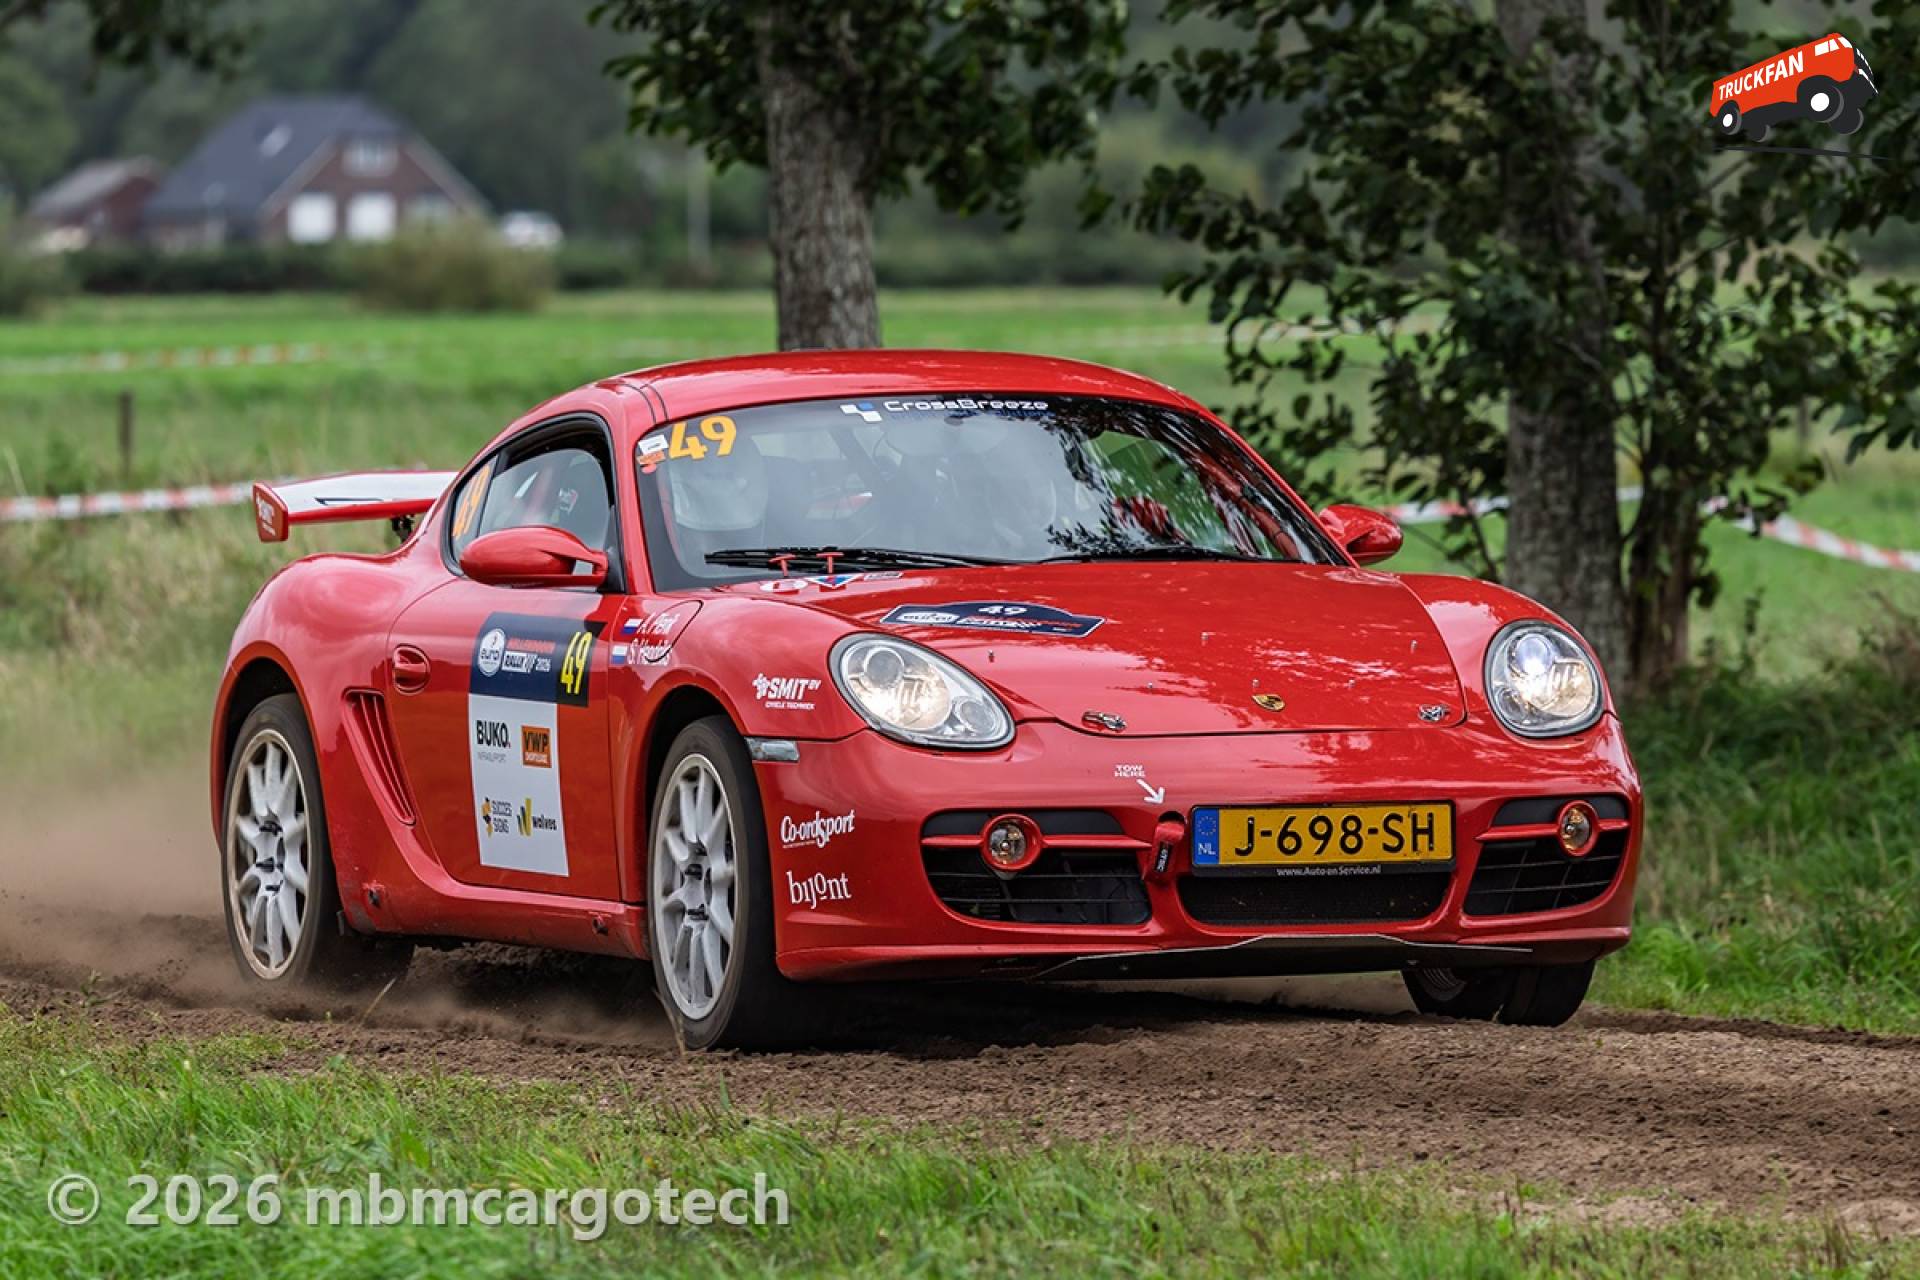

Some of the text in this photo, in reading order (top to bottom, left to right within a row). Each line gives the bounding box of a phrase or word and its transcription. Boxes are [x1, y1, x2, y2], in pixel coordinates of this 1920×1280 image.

[884, 400, 1048, 412] CrossBreeze
[668, 415, 737, 460] 49
[979, 605, 1027, 615] 49
[561, 631, 593, 694] 49
[767, 677, 809, 700] SMIT
[1114, 770, 1146, 778] HERE
[780, 809, 856, 848] Co-ordsport
[1234, 812, 1434, 857] J-698-SH
[1197, 842, 1217, 856] NL
